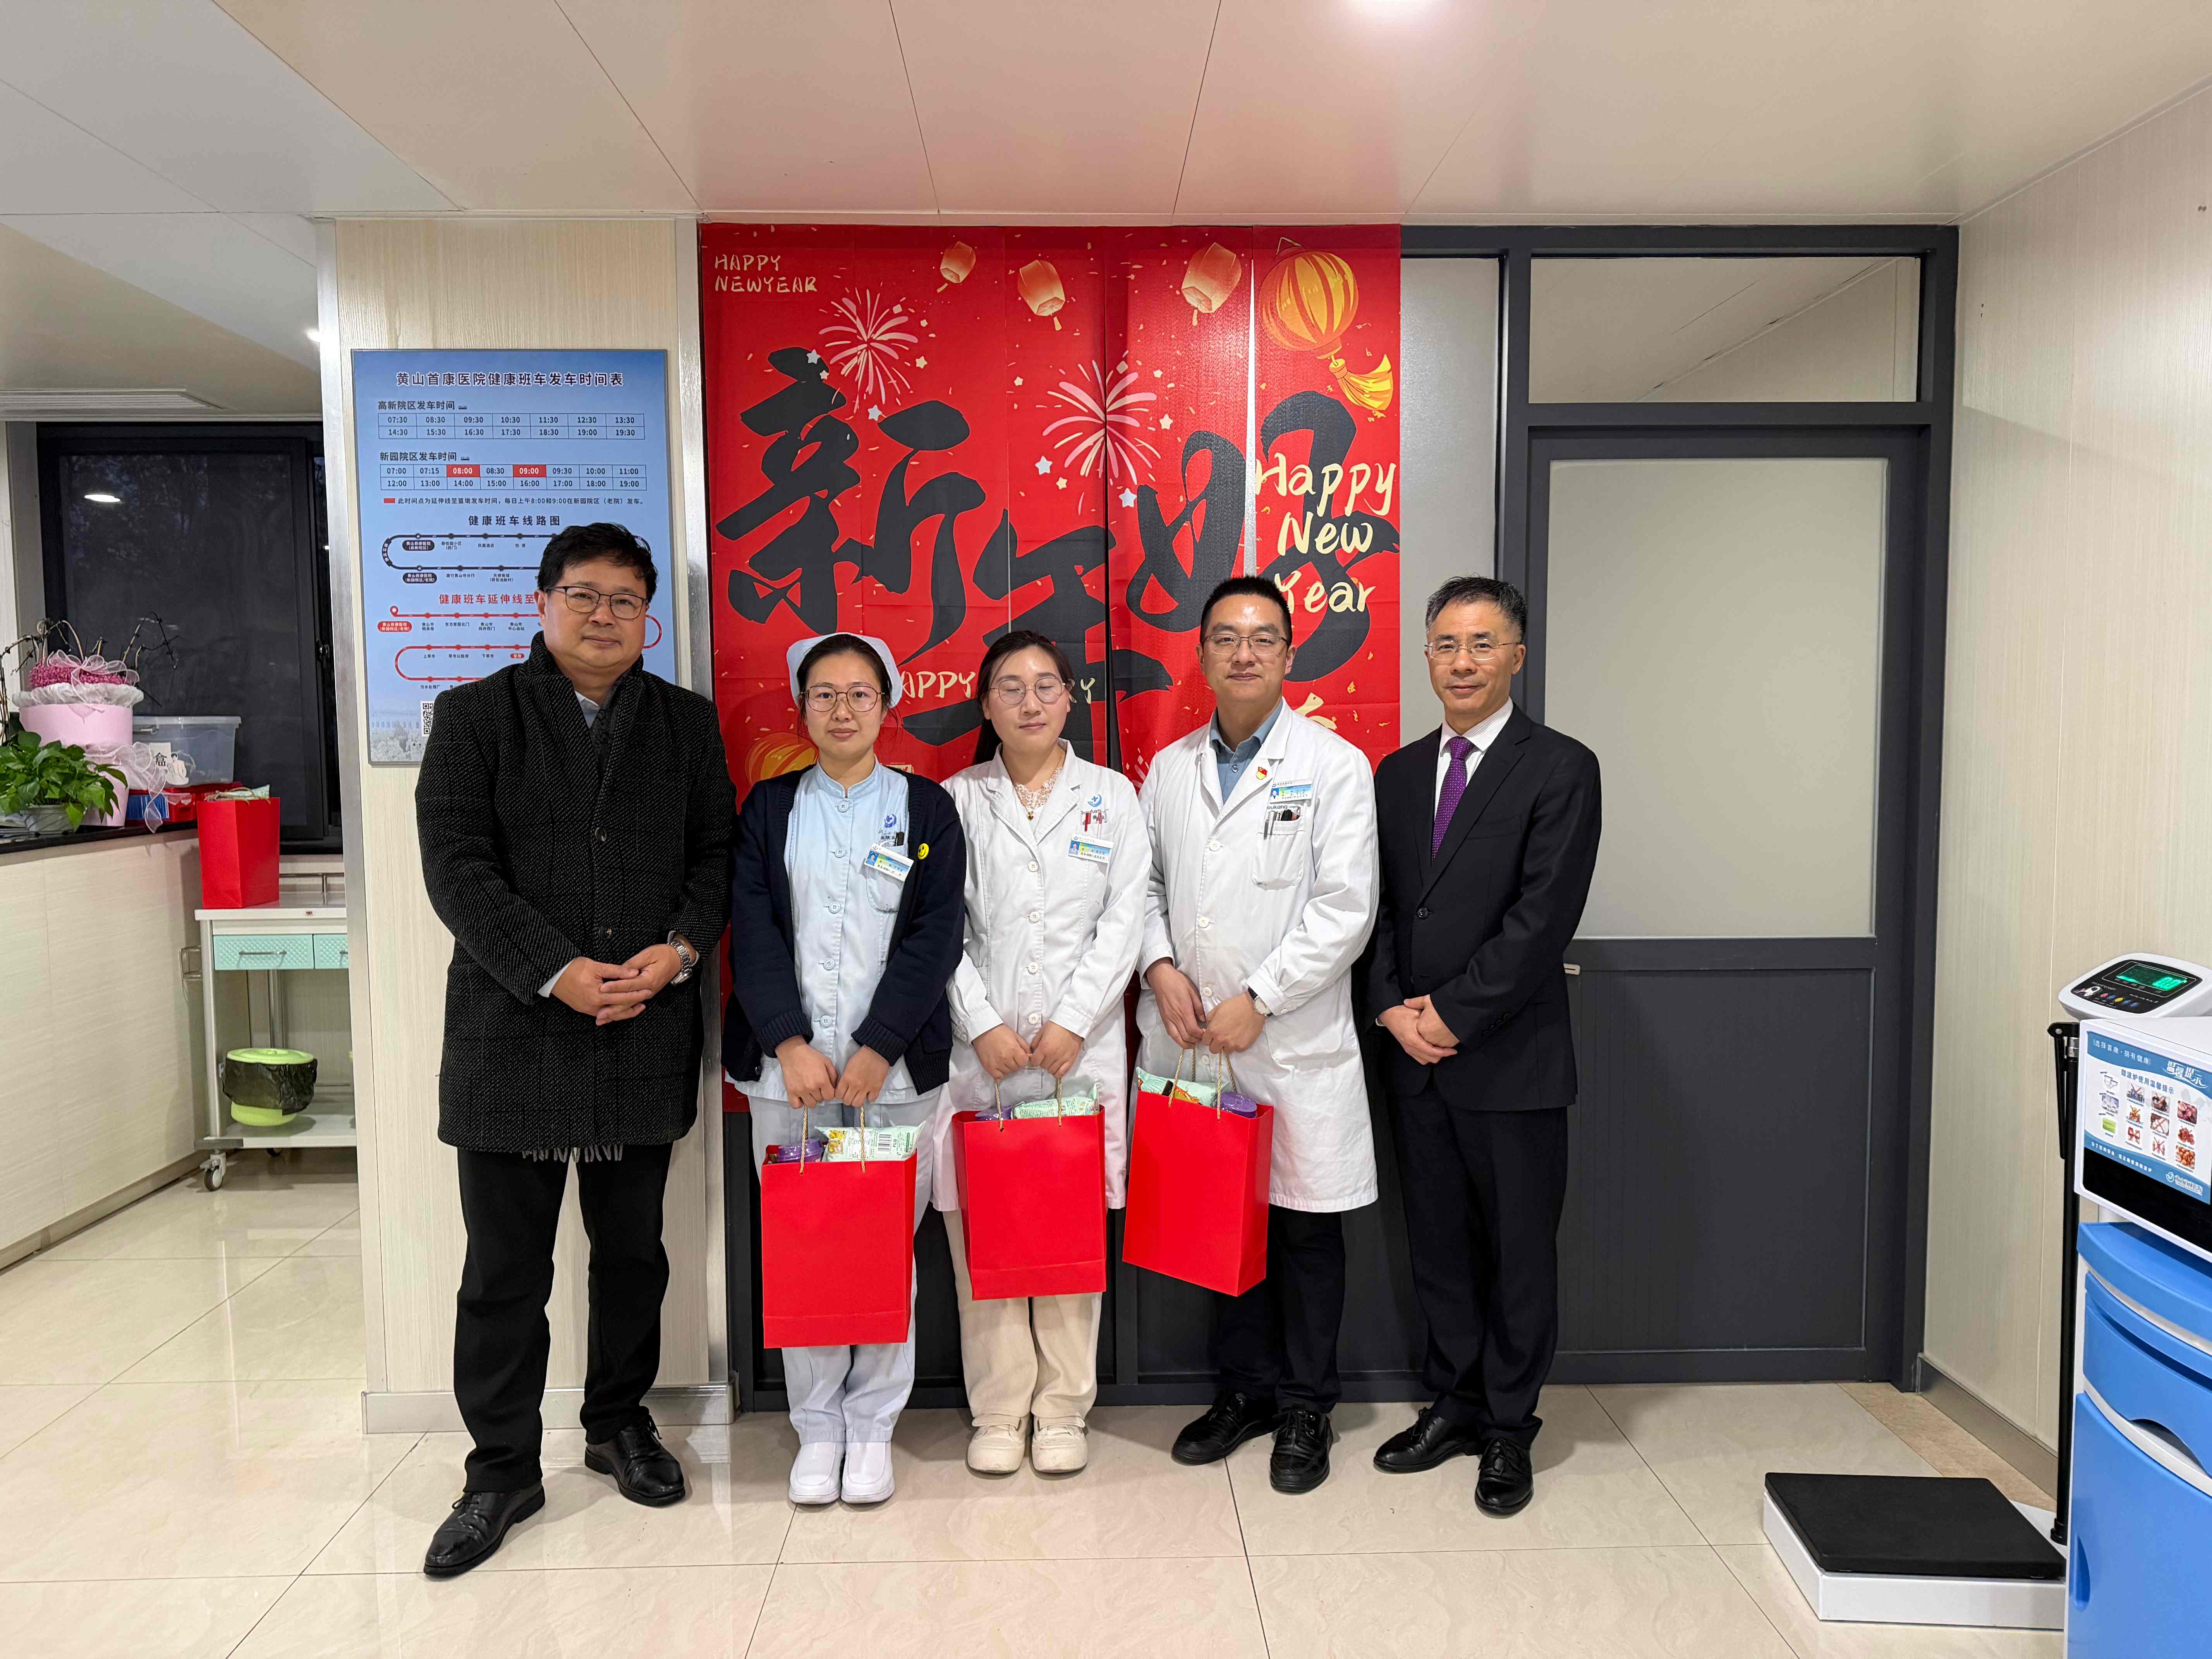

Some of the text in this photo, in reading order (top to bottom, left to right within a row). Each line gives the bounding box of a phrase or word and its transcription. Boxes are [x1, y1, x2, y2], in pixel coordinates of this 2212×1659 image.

[714, 254, 781, 271] HAPPY
[715, 275, 817, 293] NEWYEAR
[396, 372, 623, 386] 黄山首康医院健康班车发车时间表
[378, 401, 455, 410] 高新院区发车时间
[380, 452, 457, 461] 新园院区发车时间
[1256, 452, 1396, 517] Happy
[468, 516, 560, 526] 健康班车线路图
[1278, 512, 1374, 556] New
[1274, 570, 1376, 613] Year
[902, 671, 975, 698] APPY
[2121, 1069, 2175, 1095] 微波炉使用温馨提示
